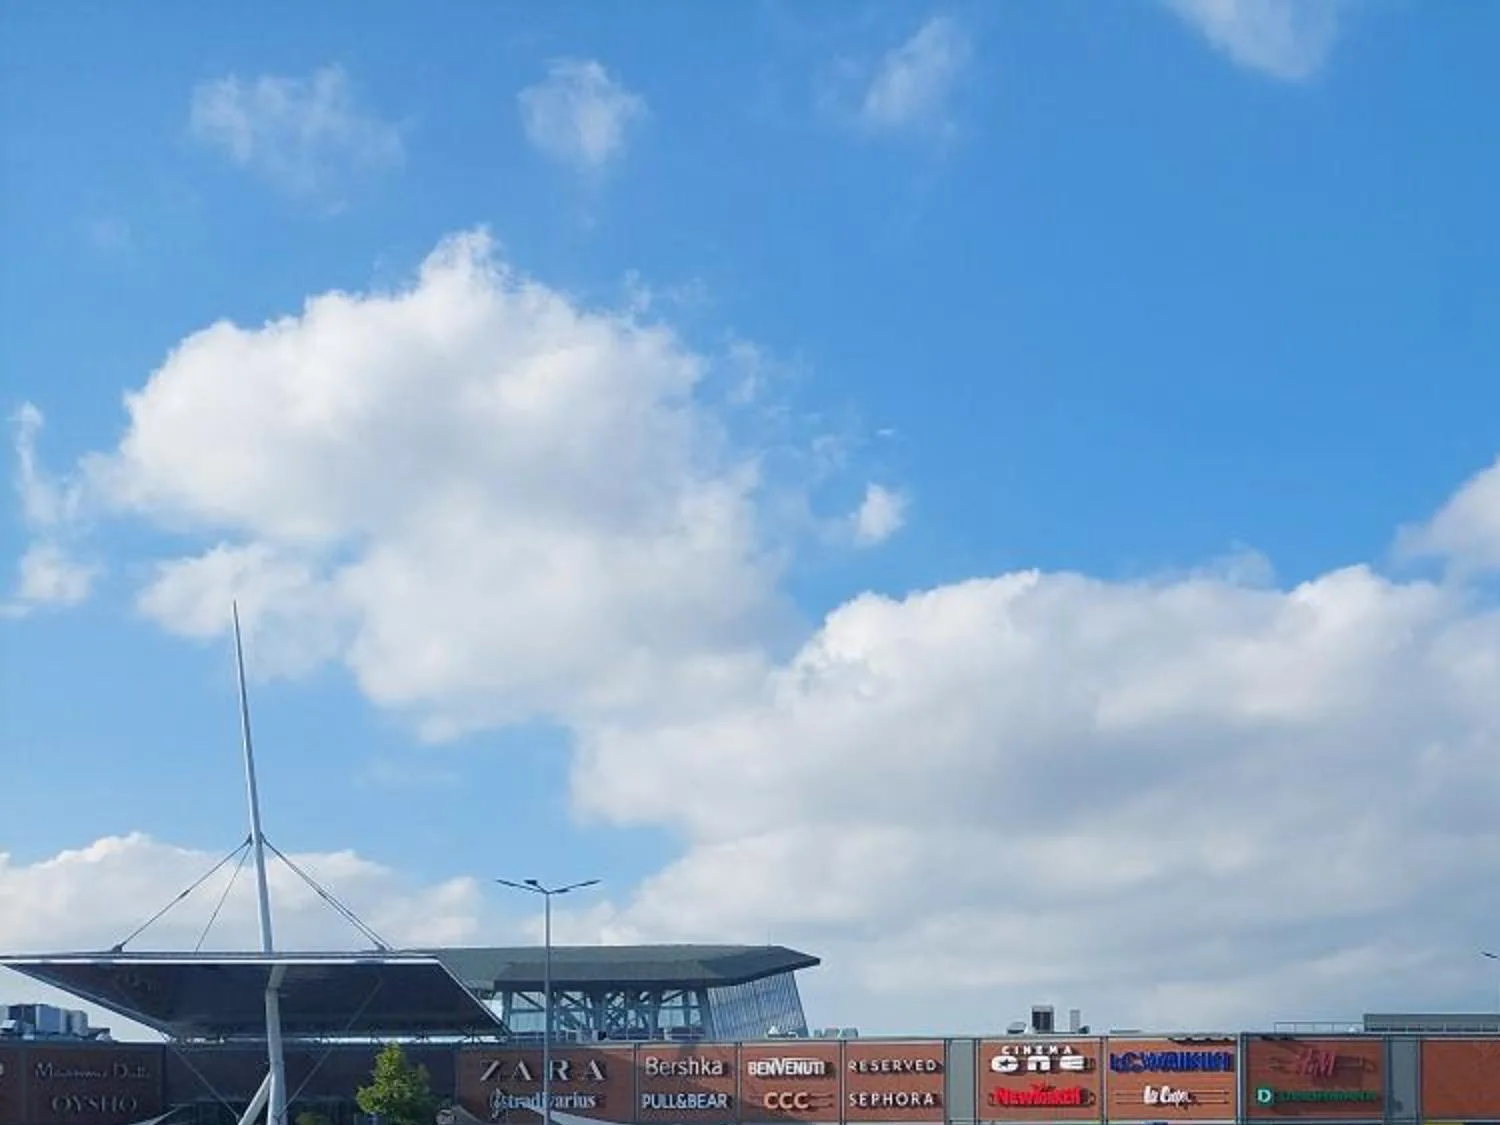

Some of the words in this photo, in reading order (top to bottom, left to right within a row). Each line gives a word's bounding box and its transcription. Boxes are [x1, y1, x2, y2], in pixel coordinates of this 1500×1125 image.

[1001, 1045, 1072, 1055] CINEMA
[479, 1059, 605, 1081] ZARA
[645, 1056, 723, 1075] Bershka
[748, 1057, 825, 1076] BENVENUTI
[848, 1059, 937, 1072] RESERVED
[641, 1093, 728, 1109] PULL&BEAR
[764, 1092, 810, 1109] CCC
[848, 1092, 935, 1106] SEPHORA
